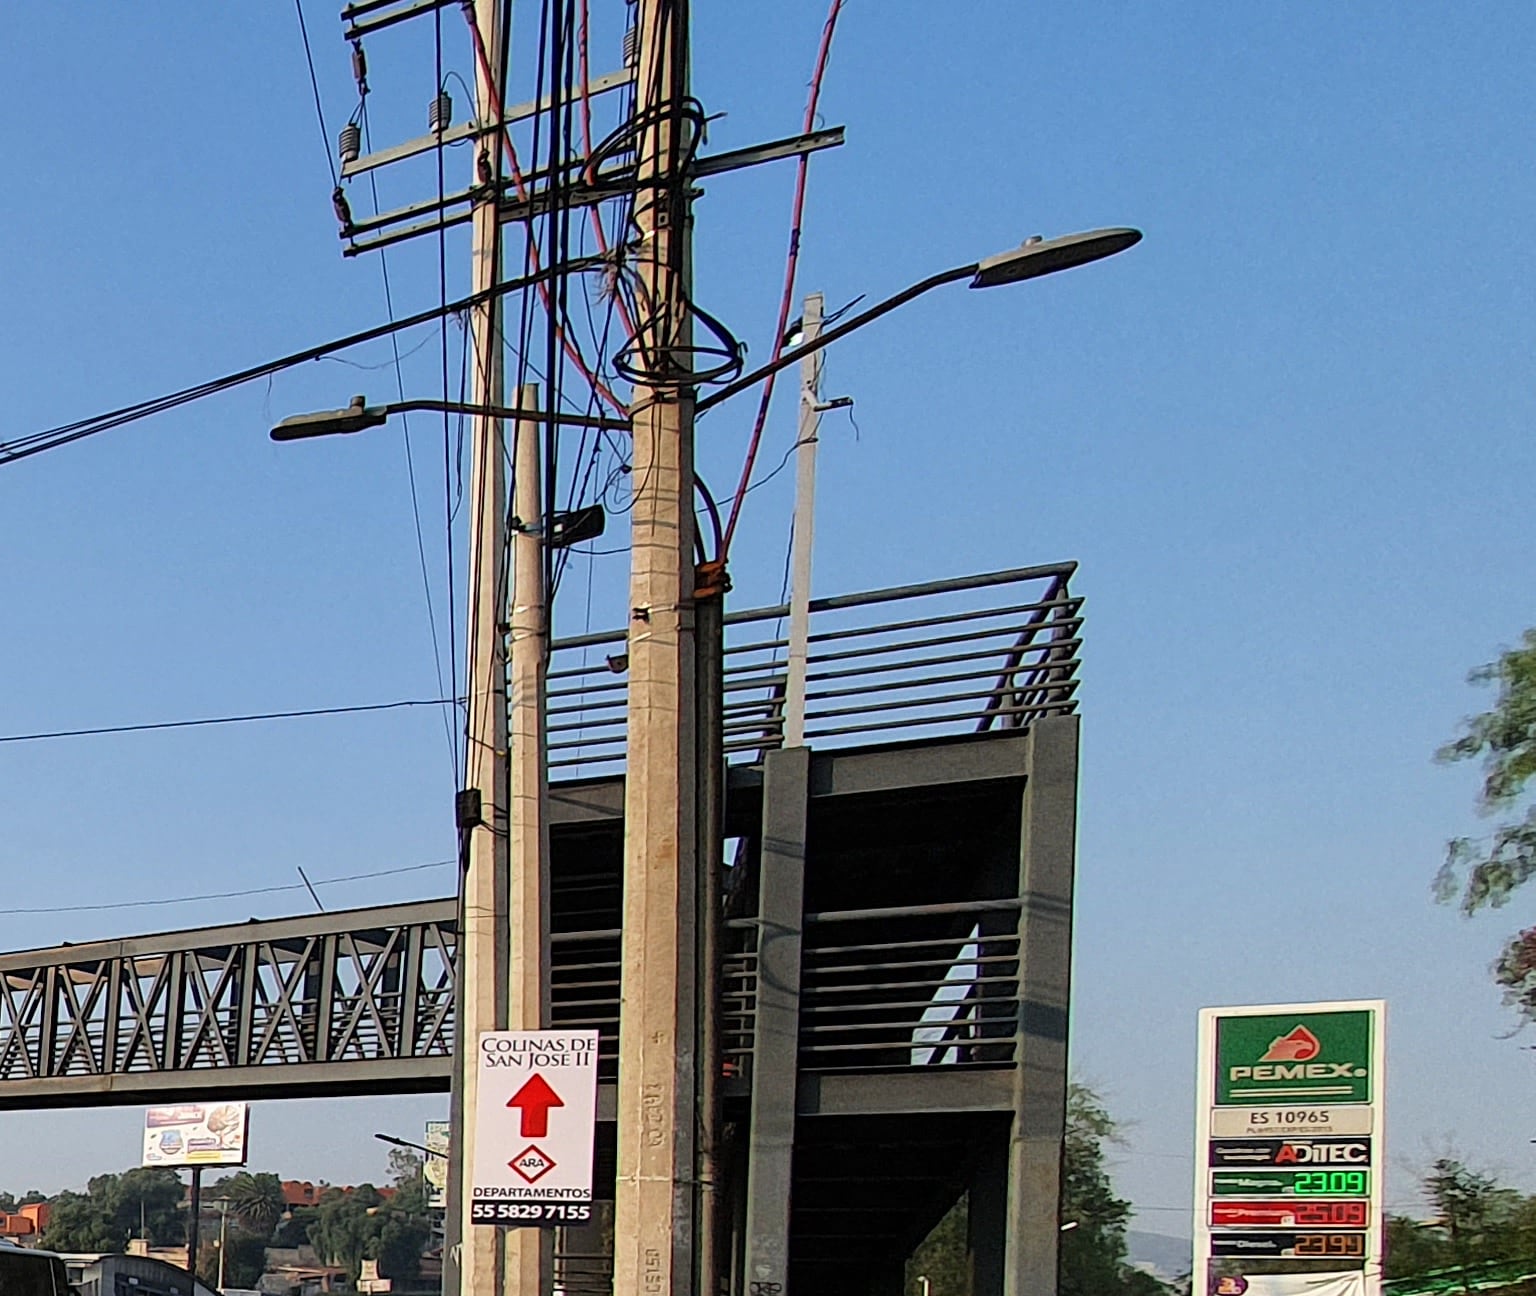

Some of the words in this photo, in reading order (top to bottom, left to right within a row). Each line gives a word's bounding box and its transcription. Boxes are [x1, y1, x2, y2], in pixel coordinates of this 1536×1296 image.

[481, 1038, 565, 1053] COLINAS
[571, 1038, 596, 1052] DE
[485, 1053, 524, 1067] SAN
[576, 1053, 590, 1066] II
[1230, 1063, 1355, 1081] PEMEX
[1250, 1112, 1269, 1125] ES
[1275, 1111, 1330, 1124] 10965
[519, 1157, 545, 1168] ARA
[473, 1187, 591, 1199] DEPARTAMENTOS
[472, 1204, 495, 1218] 55
[497, 1204, 542, 1219] 5829
[544, 1205, 590, 1220] 7155
